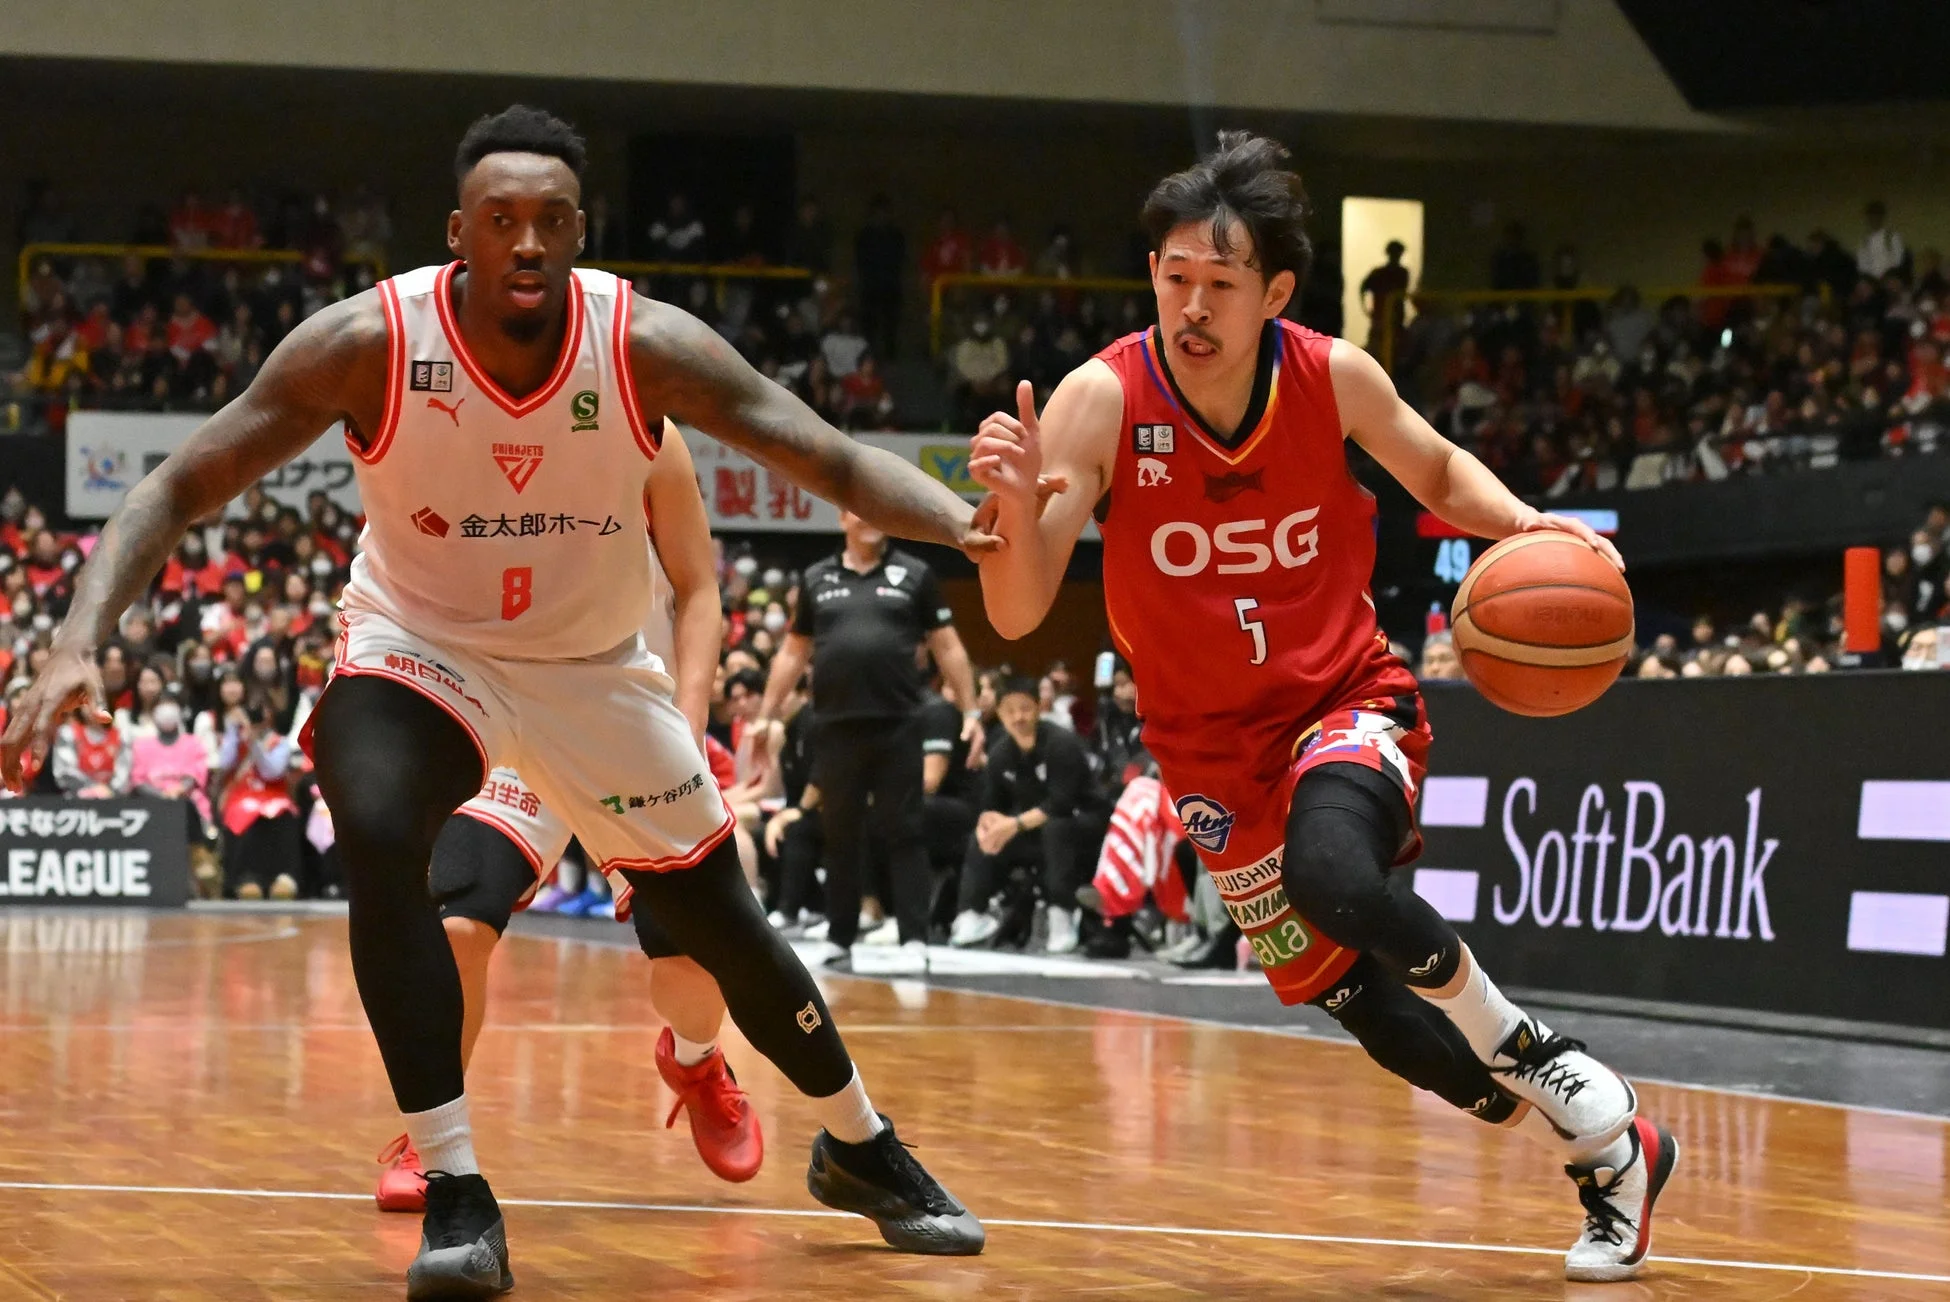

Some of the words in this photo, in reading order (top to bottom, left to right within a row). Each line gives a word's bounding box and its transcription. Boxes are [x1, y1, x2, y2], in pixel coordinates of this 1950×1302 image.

[459, 513, 622, 538] 金太郎ホーム
[1151, 505, 1320, 577] OSG
[1434, 538, 1471, 583] 49
[501, 567, 532, 621] 8
[1233, 597, 1268, 665] 5
[1493, 777, 1780, 941] SoftBank
